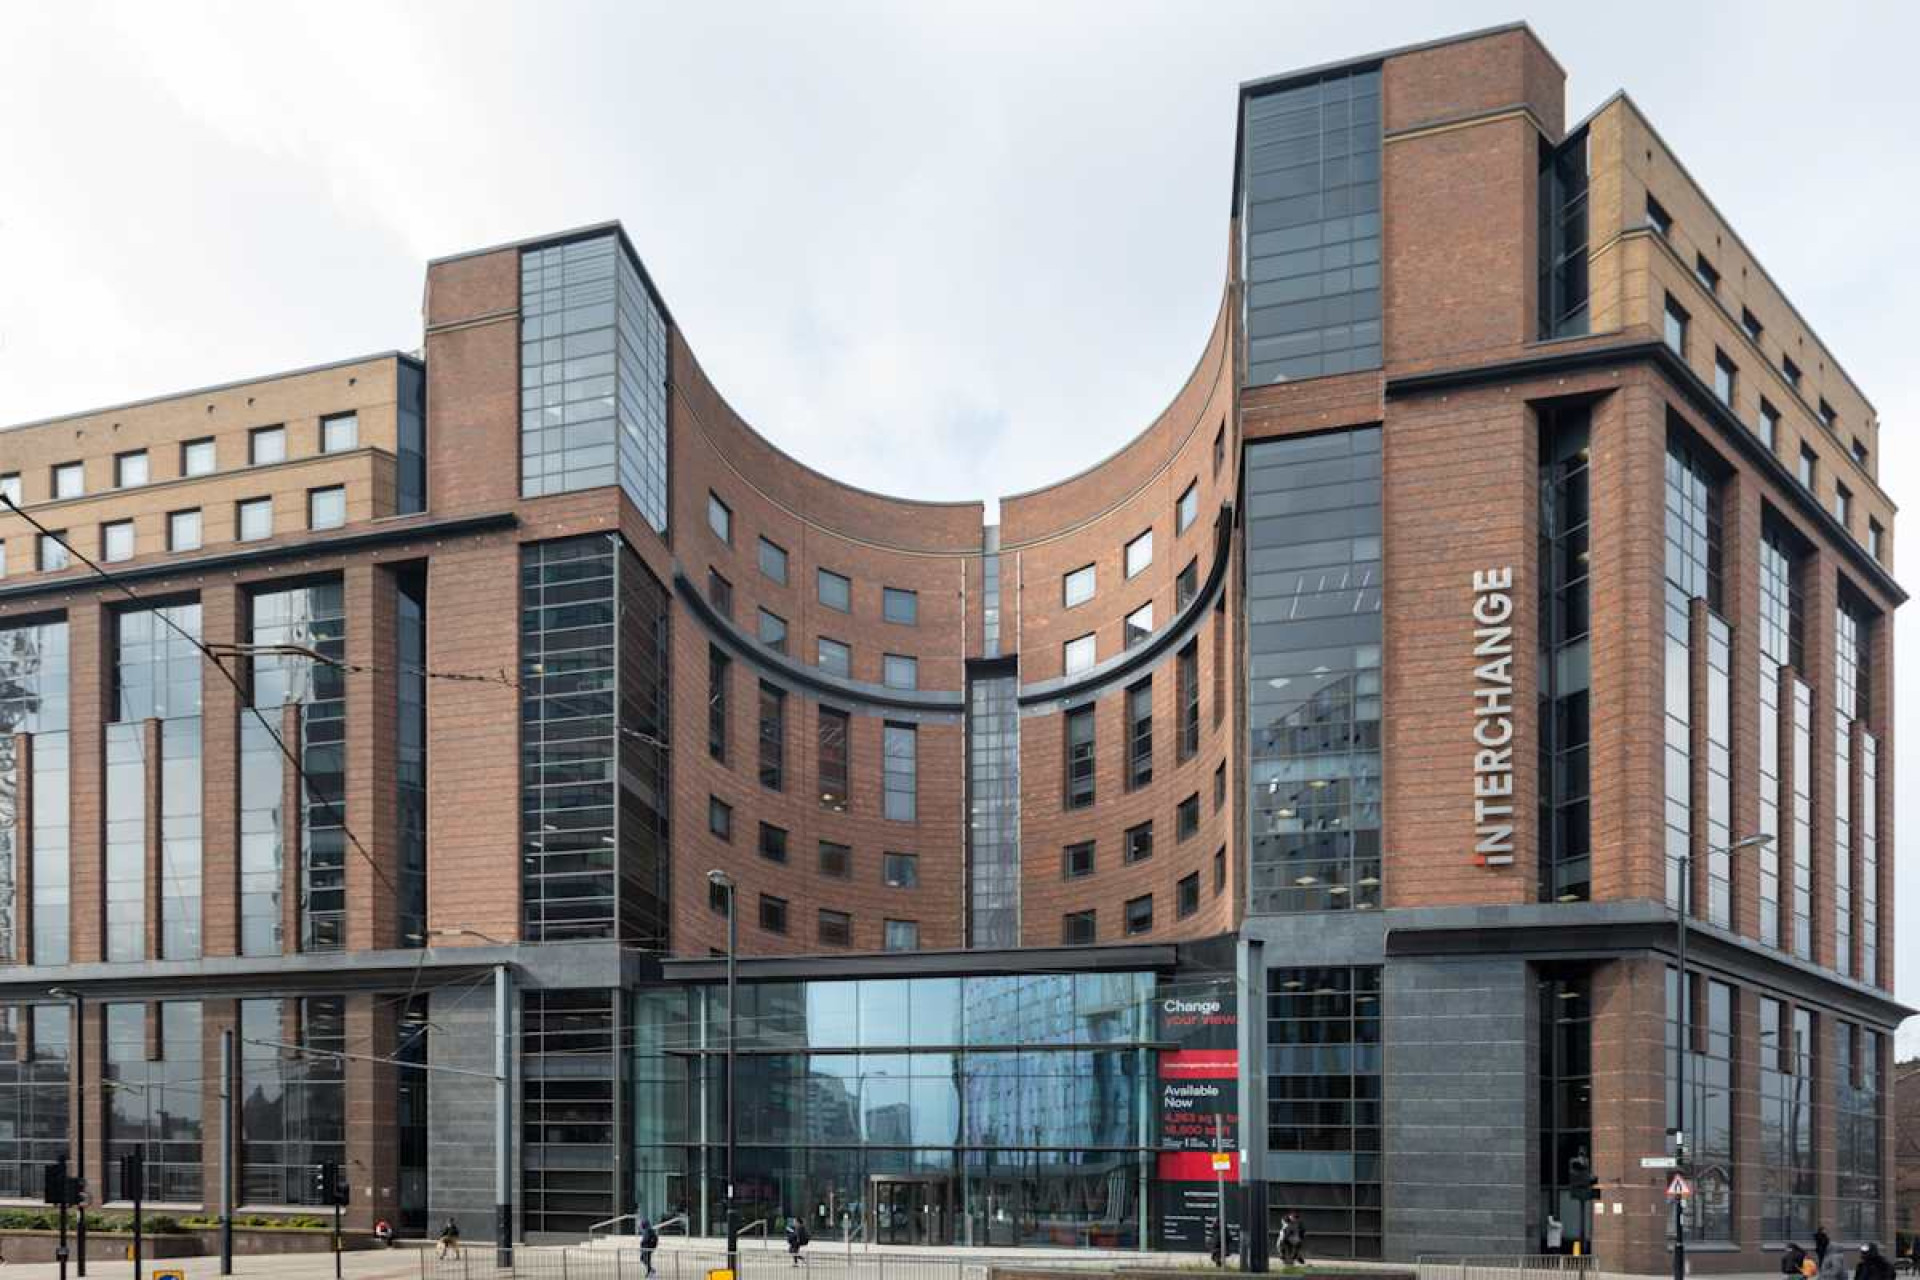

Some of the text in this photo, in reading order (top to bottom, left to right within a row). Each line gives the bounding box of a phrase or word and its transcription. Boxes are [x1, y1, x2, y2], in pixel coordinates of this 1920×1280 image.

[1164, 999, 1220, 1014] Change
[1164, 1084, 1220, 1097] Available
[1164, 1097, 1193, 1108] Now
